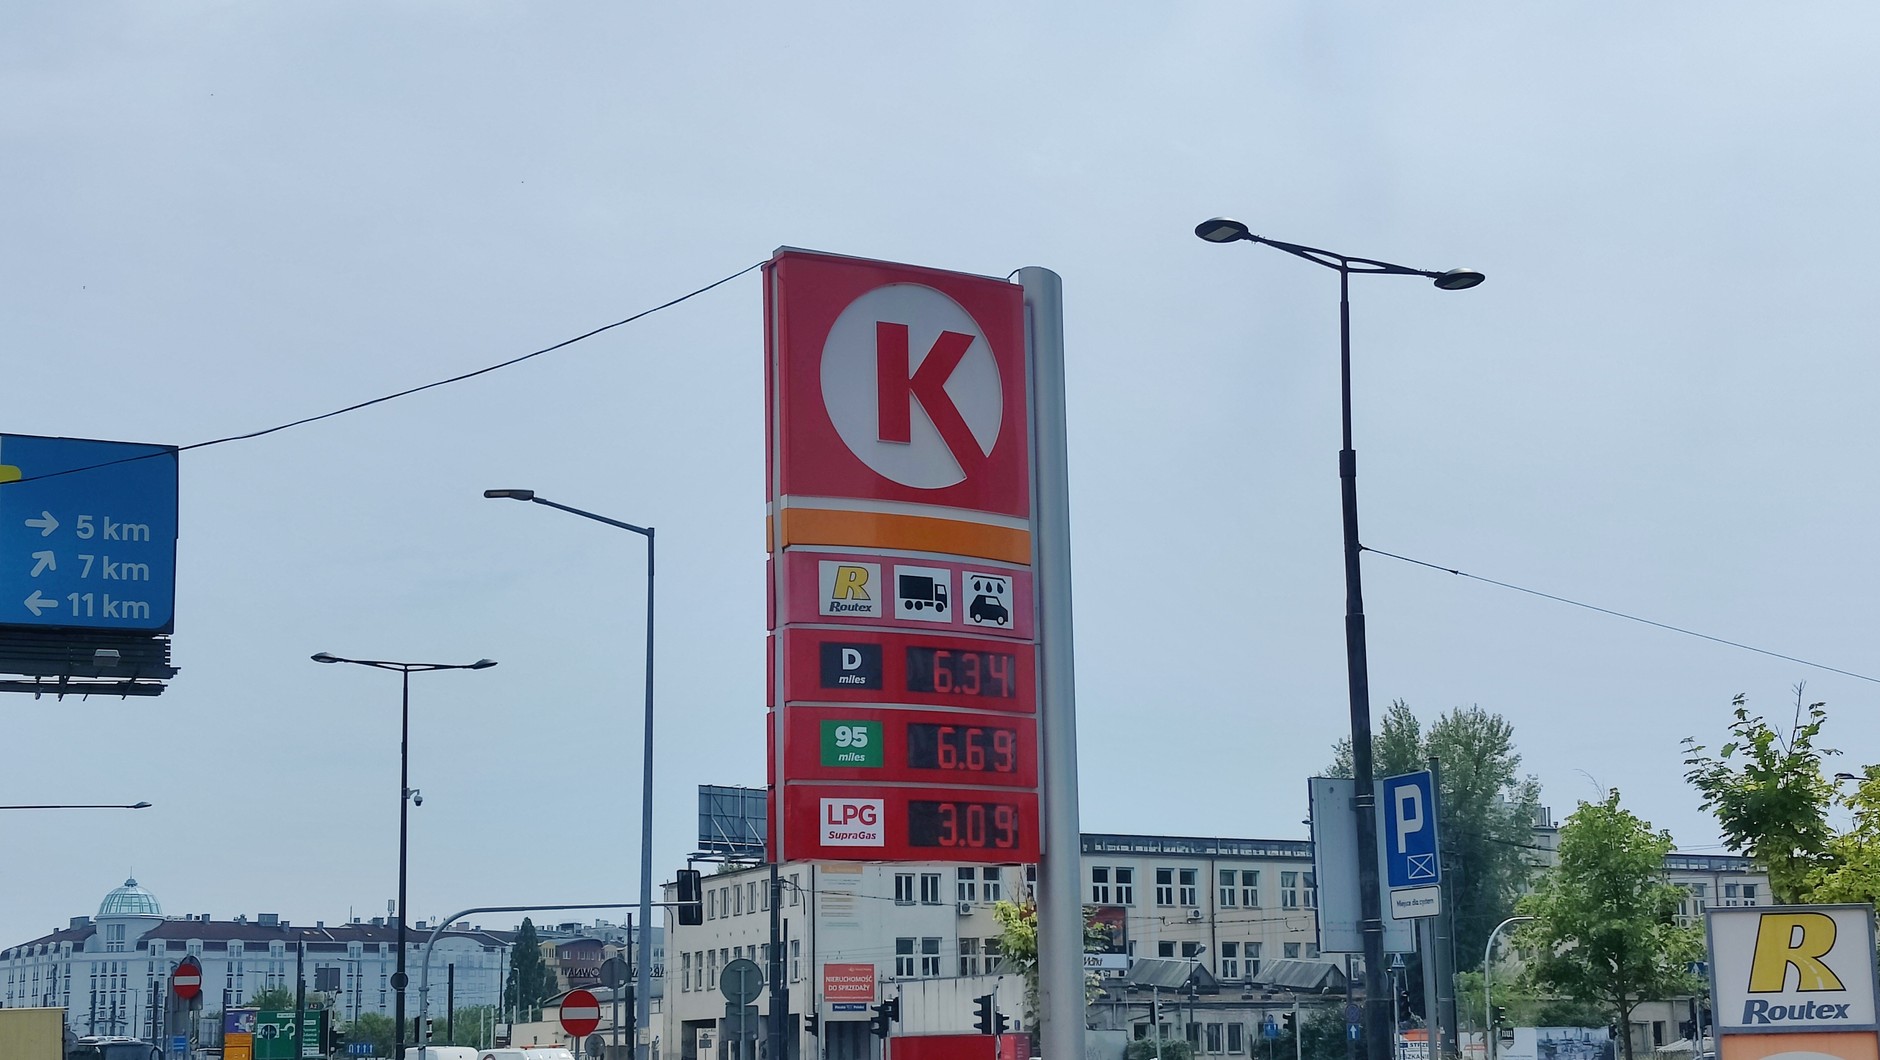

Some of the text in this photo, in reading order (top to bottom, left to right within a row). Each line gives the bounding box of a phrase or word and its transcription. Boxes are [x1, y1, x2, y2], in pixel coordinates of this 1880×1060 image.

[876, 320, 988, 480] K
[76, 514, 150, 542] 5 km
[78, 554, 150, 581] 7 km
[832, 565, 871, 601] R
[67, 592, 150, 619] 11 km
[829, 601, 872, 612] Routex
[842, 648, 862, 670] D
[838, 675, 866, 684] miles
[933, 650, 1009, 698] 6.34
[834, 725, 869, 748] 95
[937, 726, 1012, 772] 6.69
[838, 752, 866, 762] miles
[827, 804, 877, 826] LPG
[937, 803, 1014, 848] 3.09
[1394, 783, 1424, 854] P
[828, 831, 877, 840] SupraGas
[1747, 912, 1847, 994] R
[825, 975, 873, 983] NIERUCHOMOŚĆ
[1742, 999, 1850, 1025] Routex
